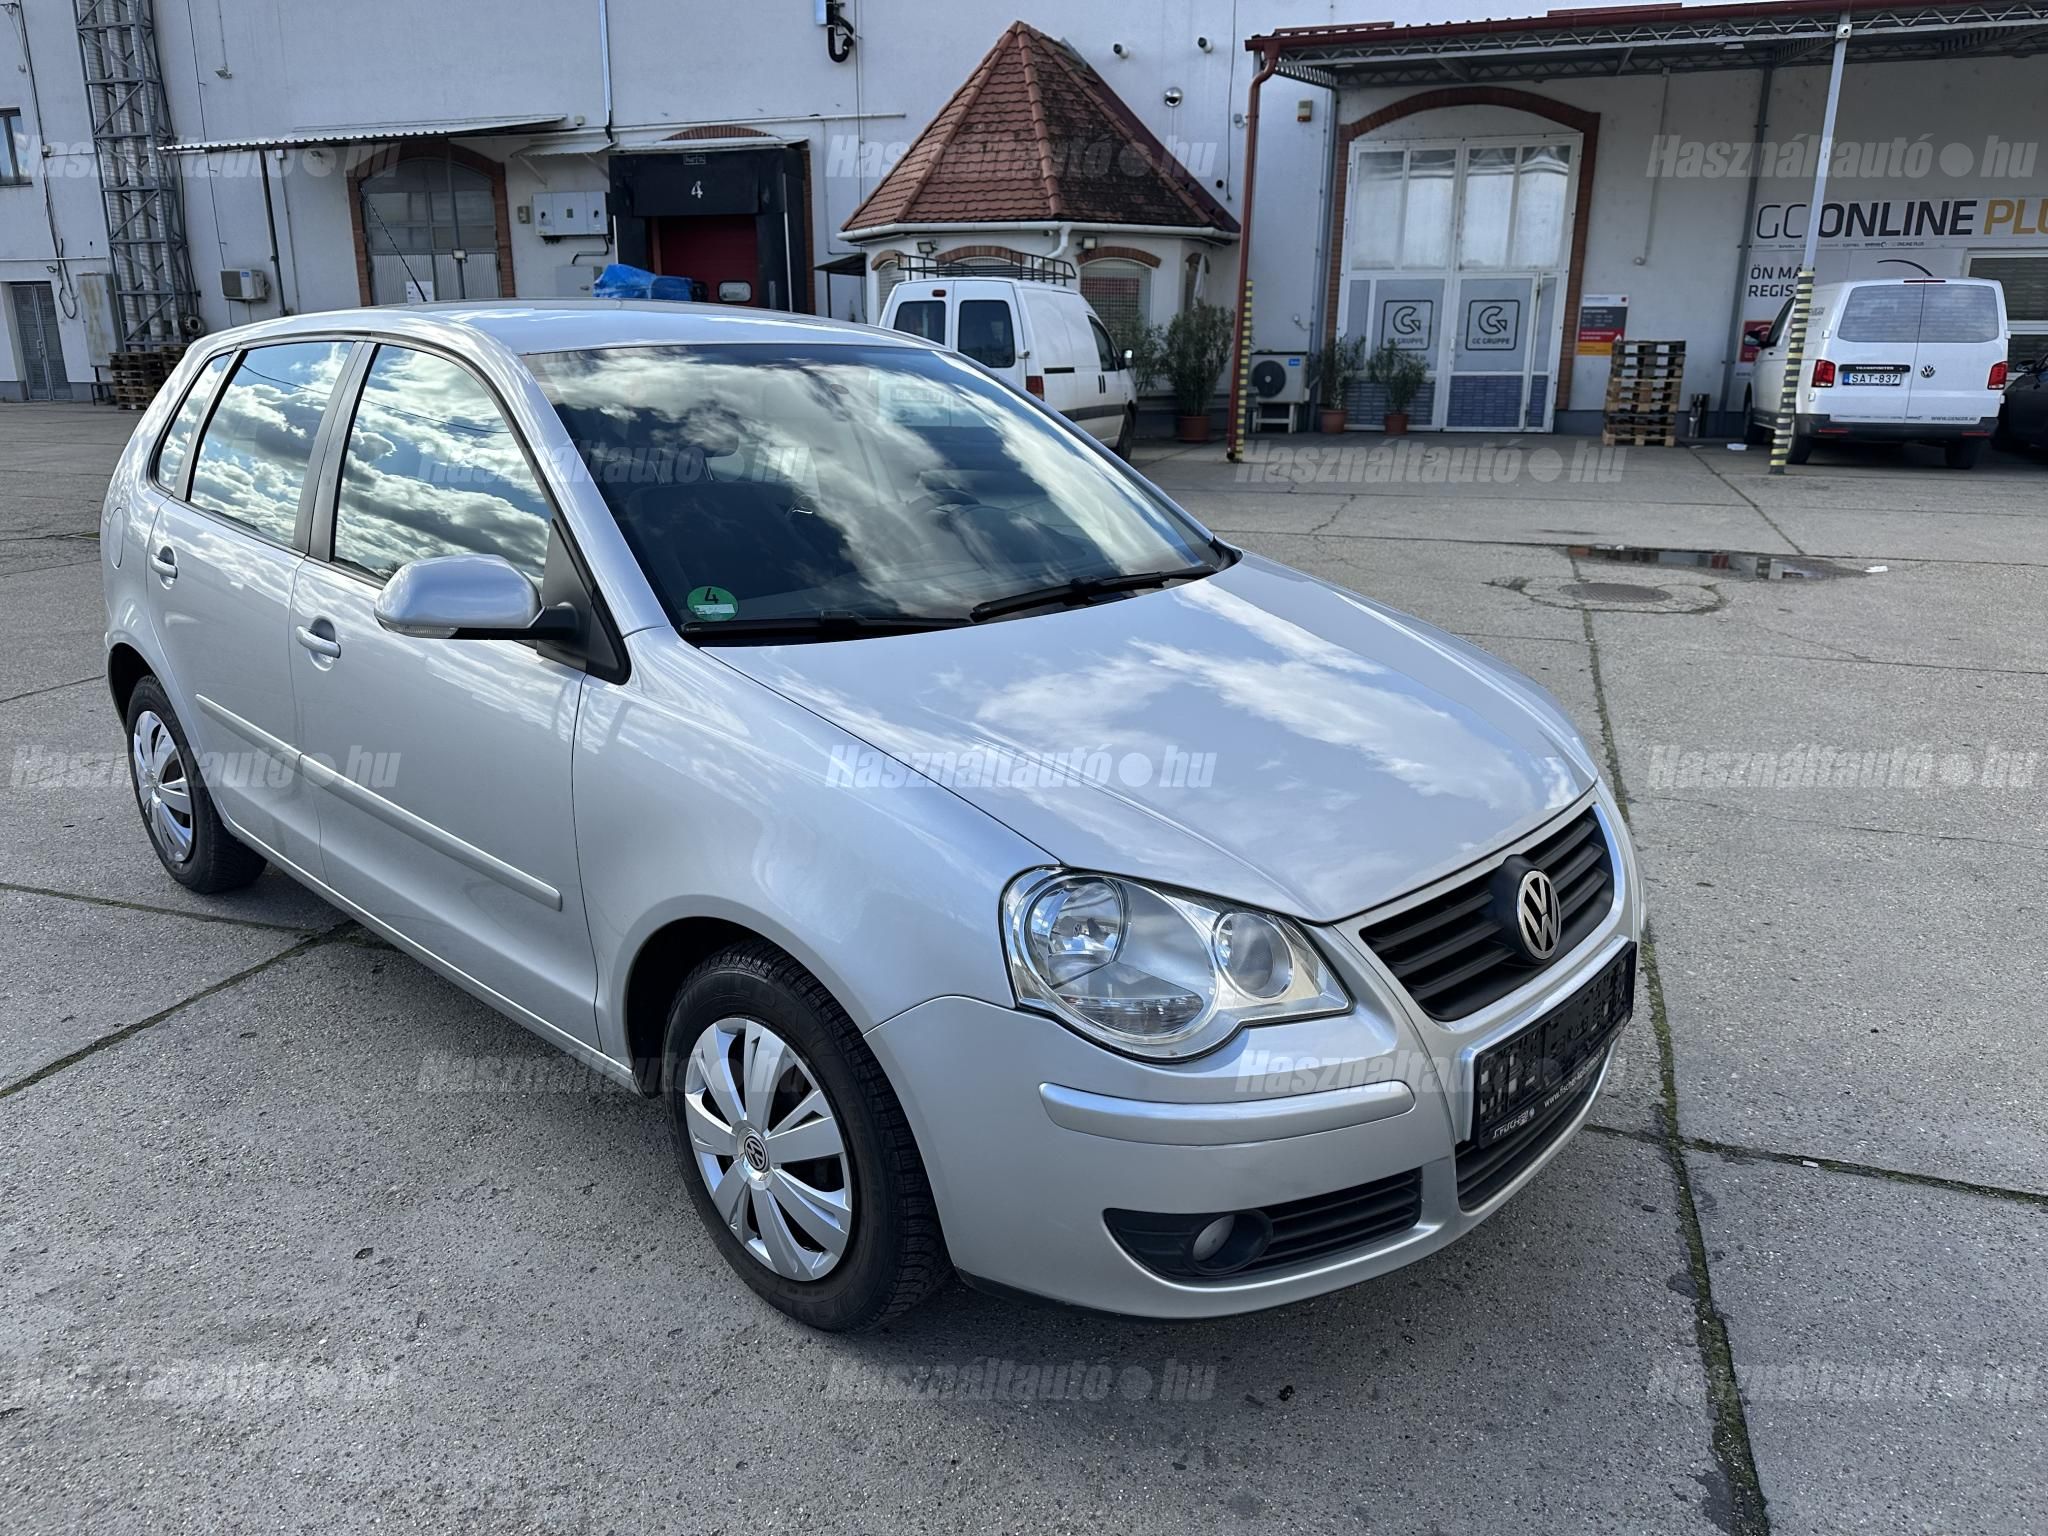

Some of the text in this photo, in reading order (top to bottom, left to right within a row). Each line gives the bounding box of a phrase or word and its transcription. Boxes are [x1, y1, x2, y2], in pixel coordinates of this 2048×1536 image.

[691, 180, 703, 198] 4
[1750, 264, 1774, 280] ÖN
[1851, 374, 1899, 383] SAT-837
[704, 587, 719, 604] 4
